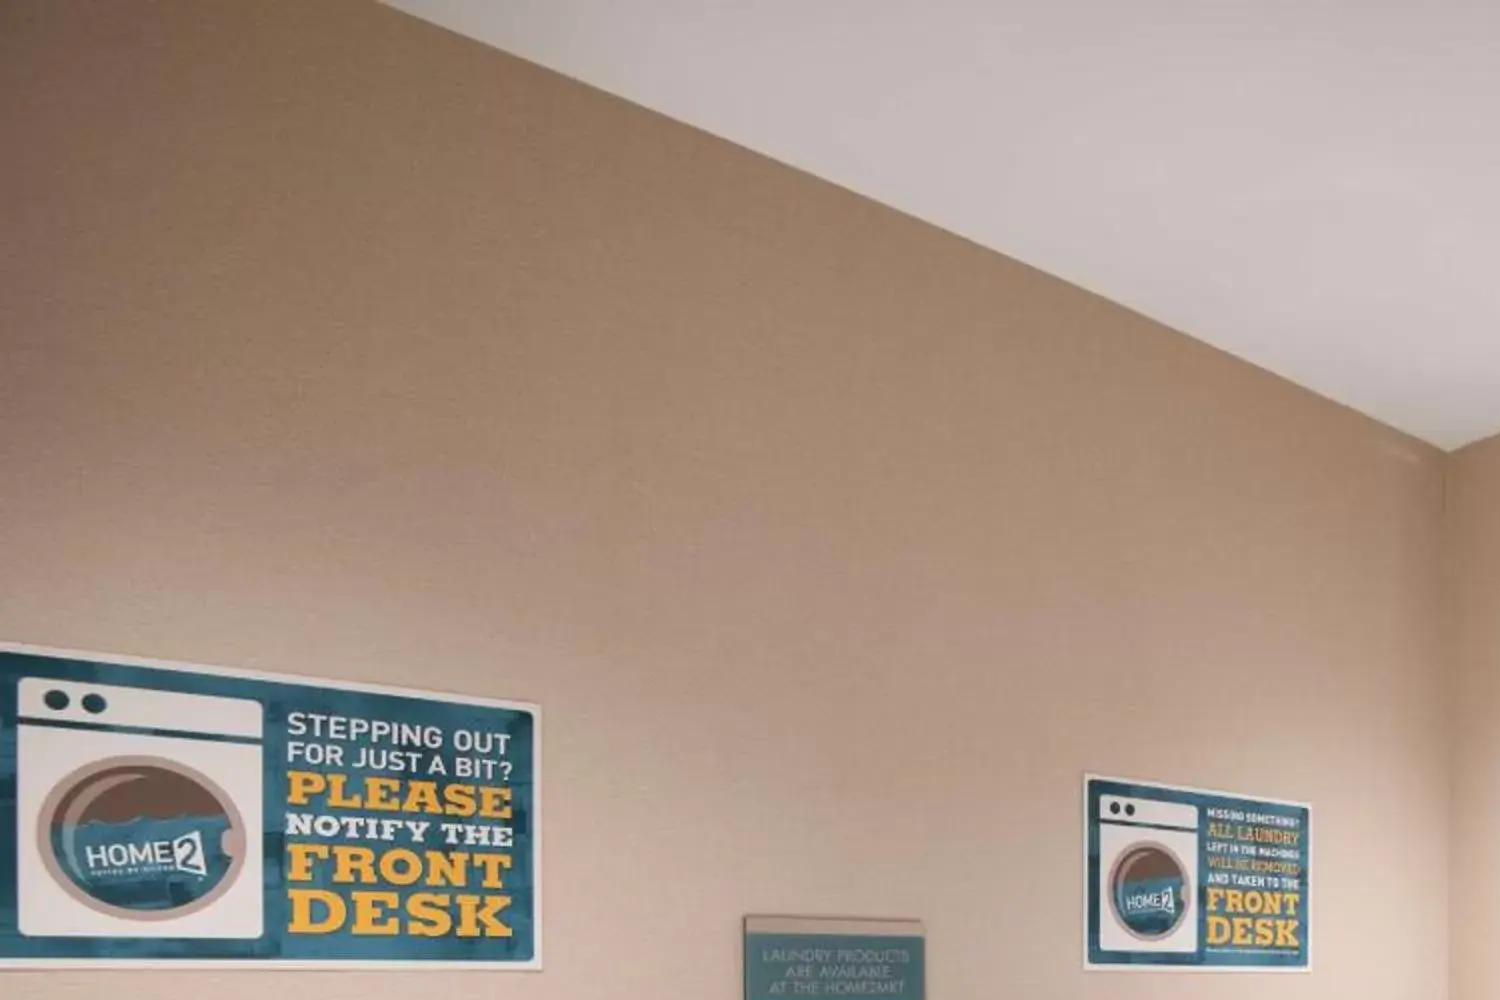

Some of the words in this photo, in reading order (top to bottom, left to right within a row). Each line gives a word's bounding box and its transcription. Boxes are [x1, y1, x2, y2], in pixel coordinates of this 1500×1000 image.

[287, 712, 443, 748] STEPPING
[453, 730, 511, 755] OUT
[287, 741, 344, 766] FOR
[352, 748, 422, 773] JUST
[428, 755, 446, 776] A
[455, 757, 513, 781] BIT?
[286, 770, 512, 819] PLEASE
[1206, 808, 1244, 821] MISSING
[285, 812, 430, 842] NOTIFY
[441, 823, 513, 847] THE
[1207, 822, 1234, 839] ALL
[1237, 825, 1300, 845] LAUNDRY
[1206, 841, 1228, 853] LEFT
[1230, 843, 1239, 854] IN
[1241, 845, 1257, 856] THE
[286, 843, 512, 888] FRONT
[1207, 856, 1233, 869] WILL
[1251, 860, 1300, 875] REMOVED
[1207, 873, 1229, 885] AND
[1231, 874, 1265, 888] TAKEN
[1267, 876, 1280, 889] TO
[1281, 878, 1300, 891] THE
[287, 889, 512, 937] DESK
[1206, 887, 1300, 916] FRONT
[1206, 915, 1300, 947] DESK
[762, 948, 832, 963] LAUNDRY
[837, 949, 910, 964] PRODUCTS
[785, 965, 813, 979] ARE
[819, 965, 893, 979] AVAILABLE
[769, 981, 787, 994] AT
[794, 980, 820, 994] THE
